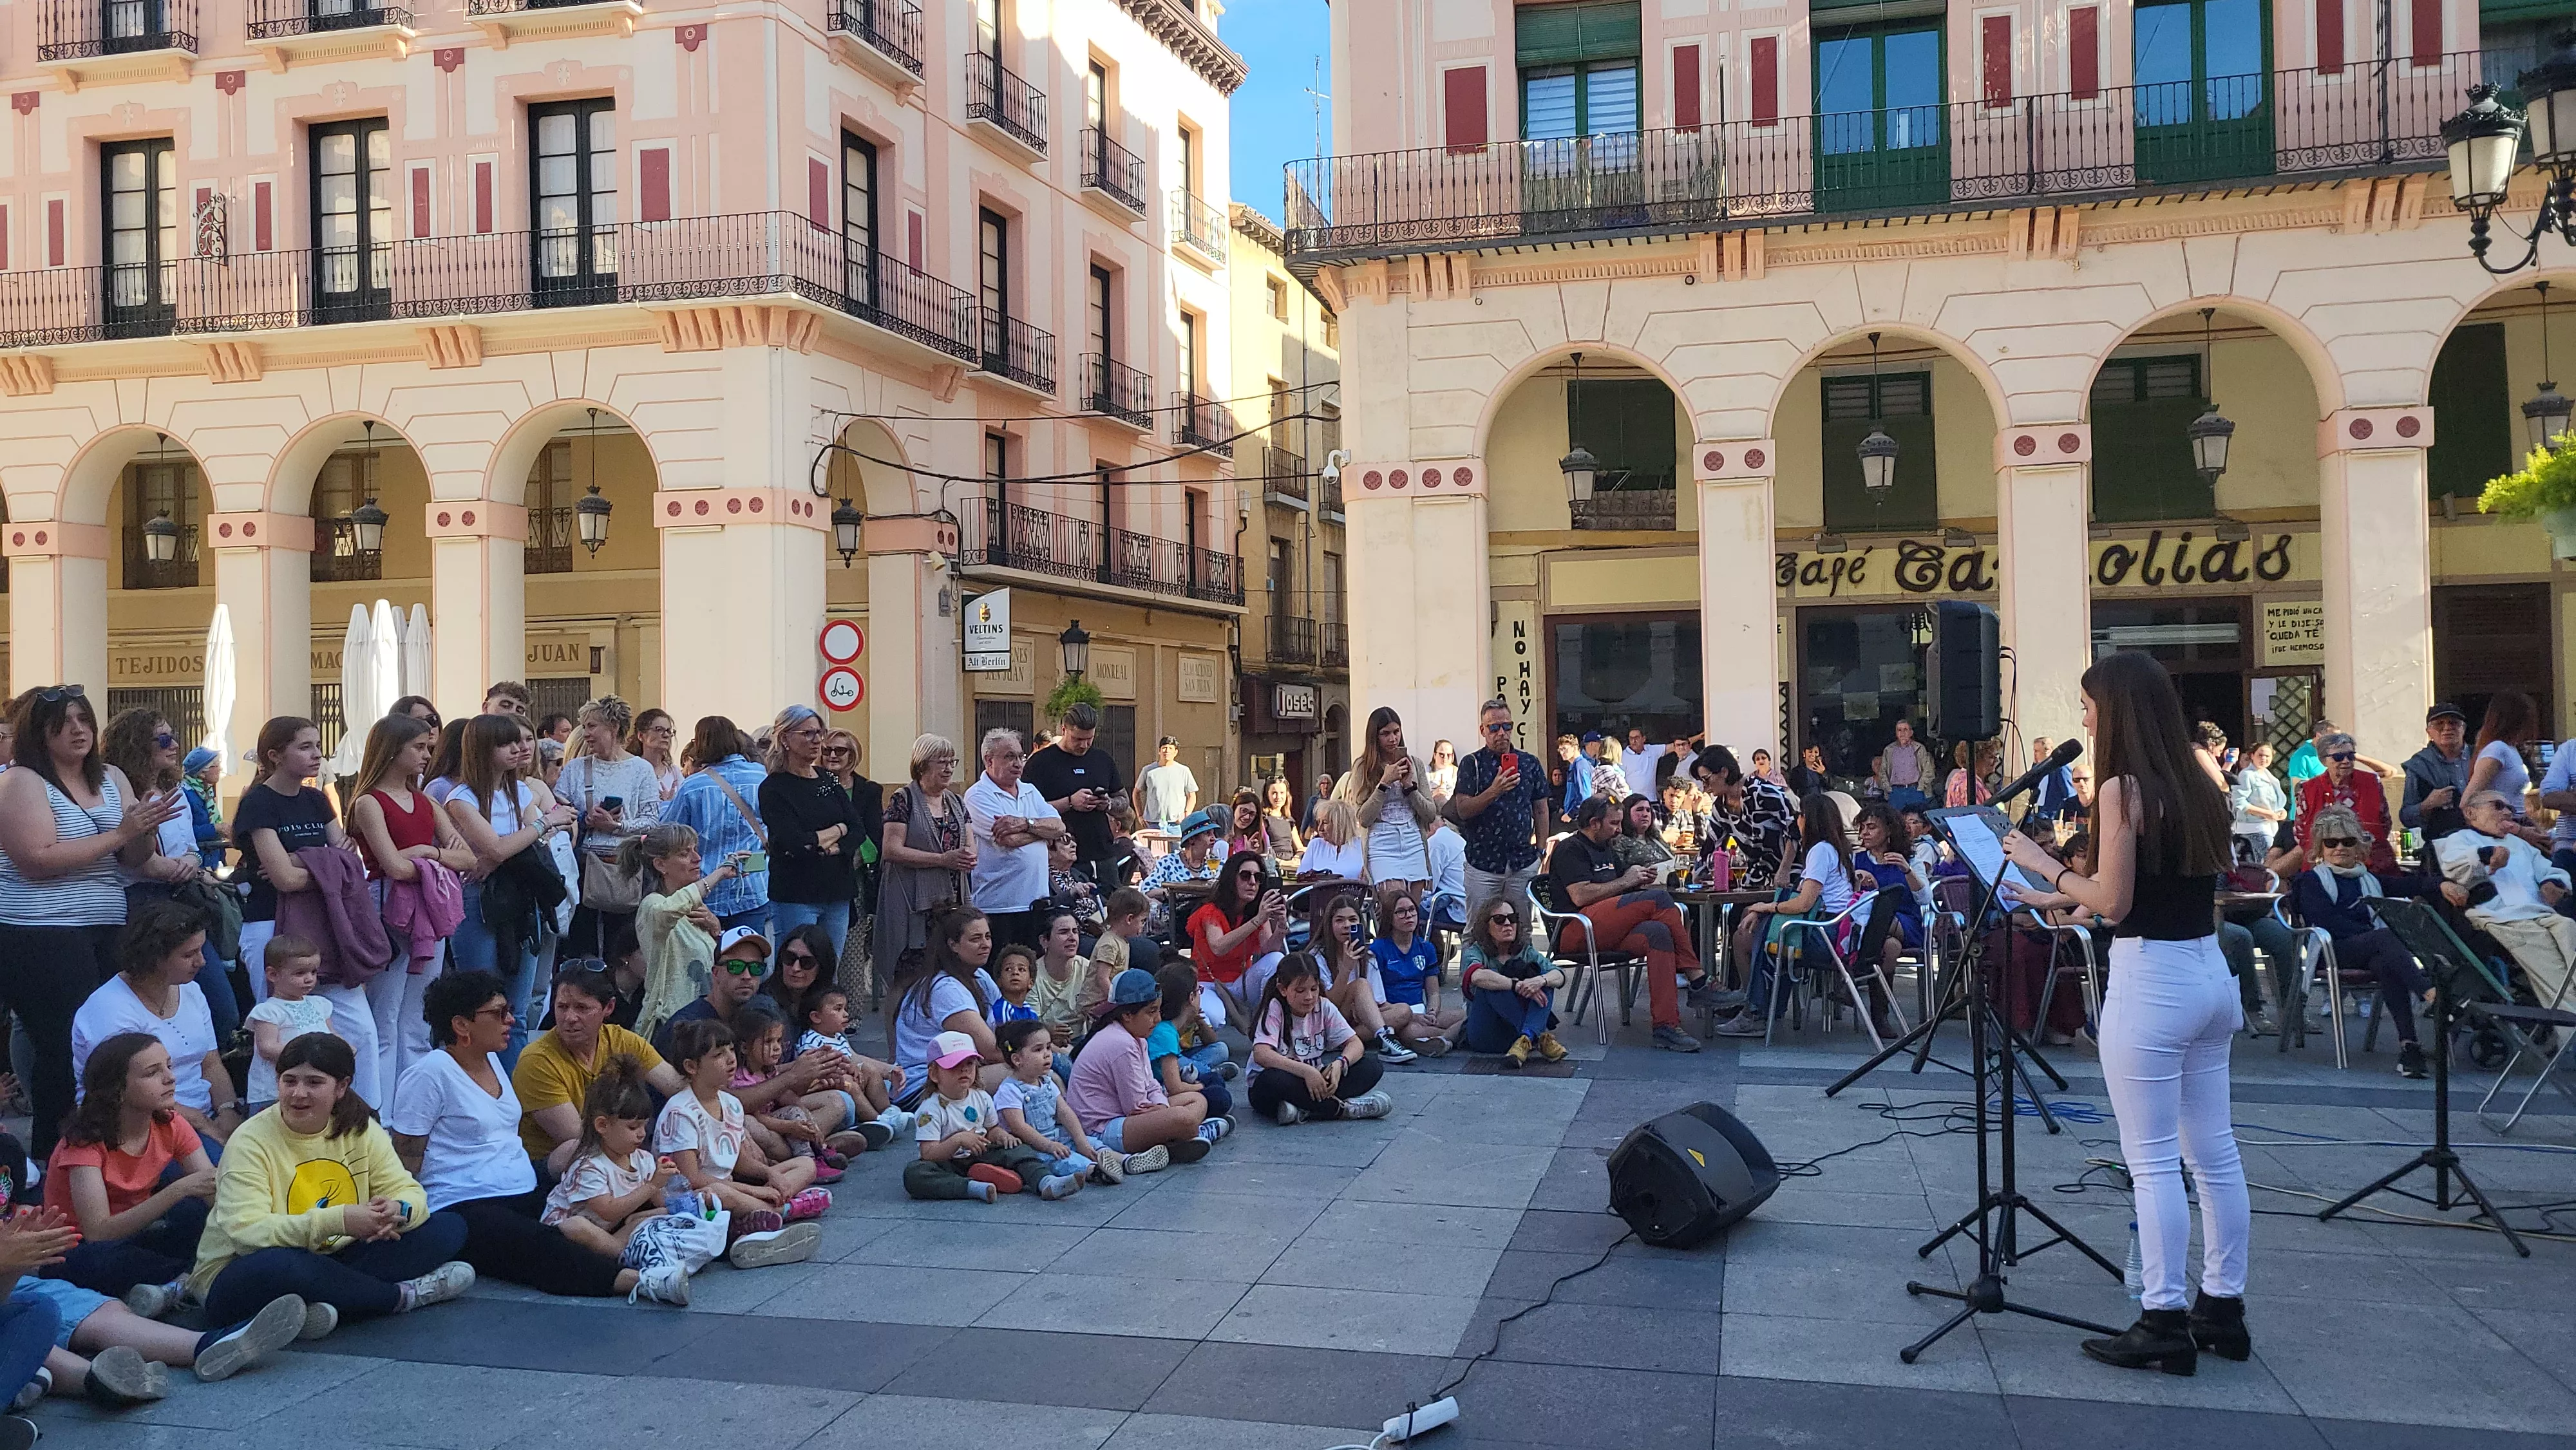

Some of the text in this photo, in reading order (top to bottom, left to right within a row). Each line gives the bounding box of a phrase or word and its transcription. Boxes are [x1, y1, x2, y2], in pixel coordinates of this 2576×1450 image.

[1776, 545, 1873, 597] Café
[2268, 608, 2280, 617] ME
[969, 624, 1003, 634] VELTINS
[527, 643, 580, 663] JUAN
[968, 657, 1006, 666] Alt Berlin
[116, 655, 204, 674] TEJIDOS
[1096, 663, 1128, 680] MONREAL
[1184, 663, 1213, 677] ALMACENES
[1185, 679, 1211, 692] SAN JUAN
[1519, 661, 1531, 715] HAY
[1517, 722, 1526, 749] CI
